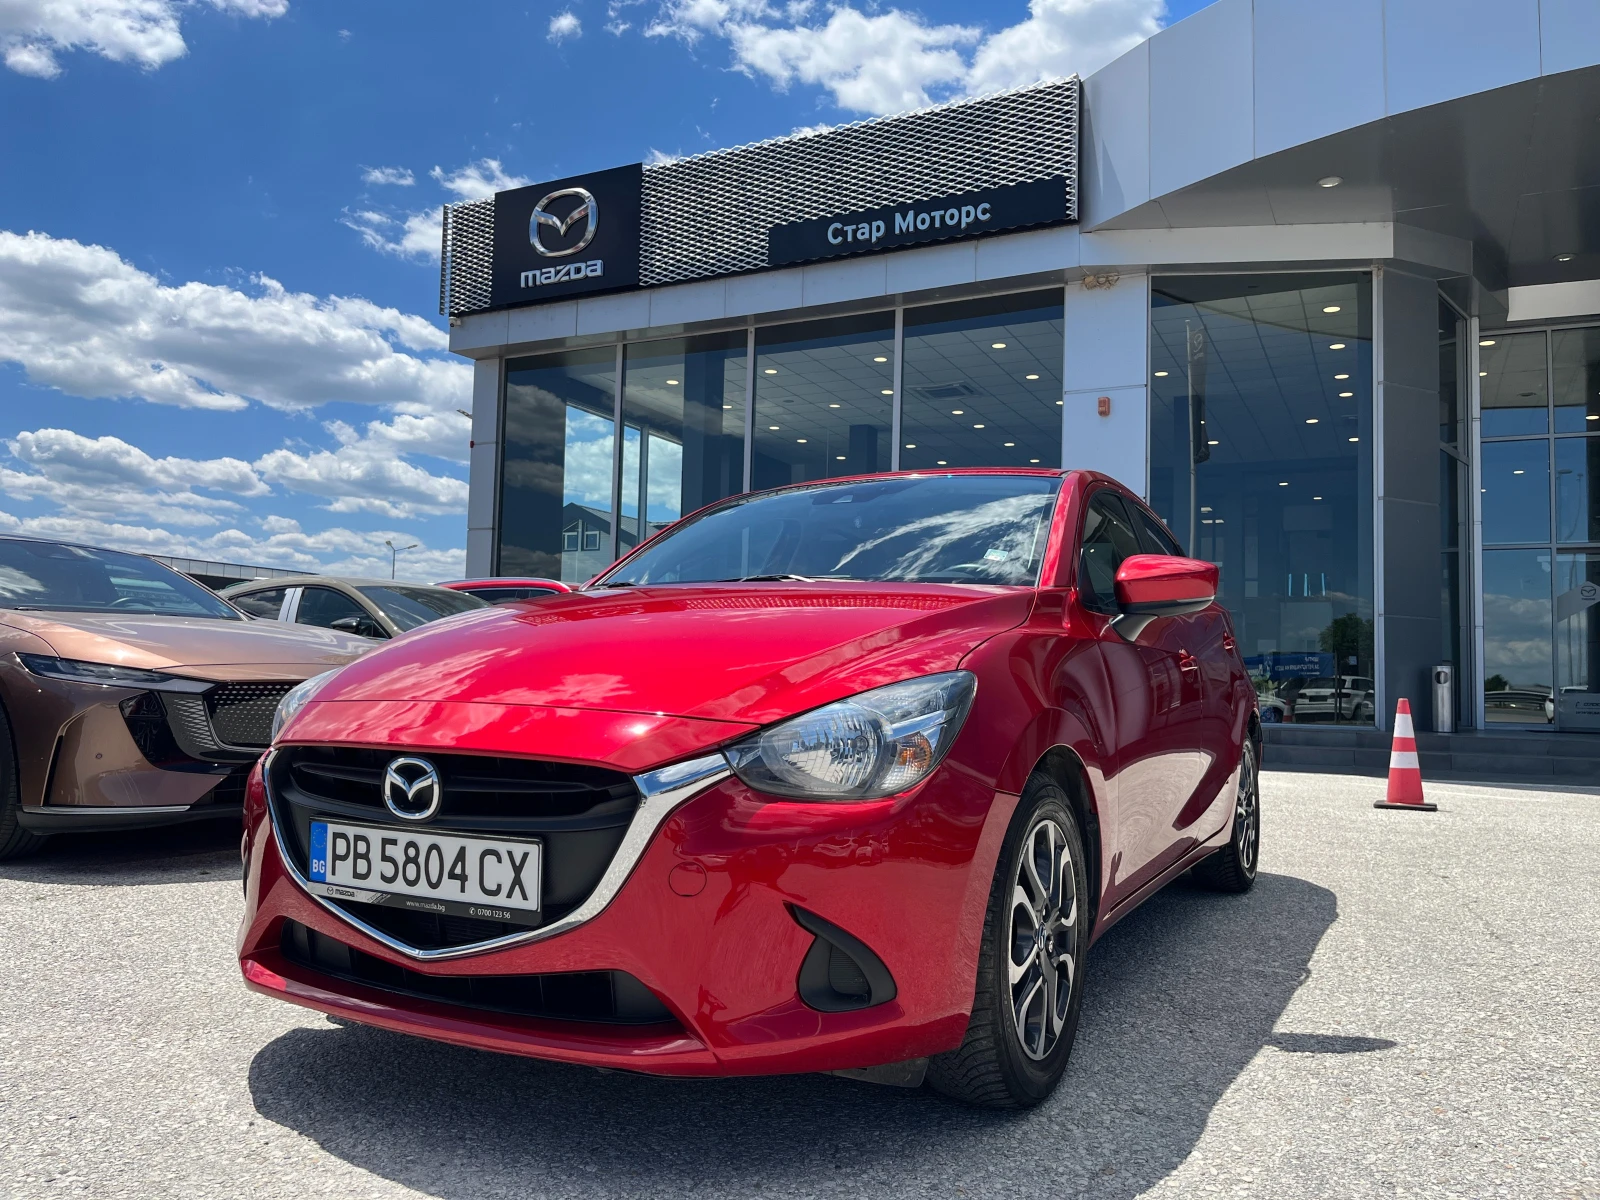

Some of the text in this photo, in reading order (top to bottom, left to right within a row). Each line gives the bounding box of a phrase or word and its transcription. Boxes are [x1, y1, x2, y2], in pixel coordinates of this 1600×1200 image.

[827, 202, 992, 245] Стар Моторс
[520, 259, 604, 288] mazda
[312, 858, 326, 874] BG
[331, 831, 530, 901] PB 5804 CX
[405, 900, 446, 912] www.mazda.bg
[477, 908, 511, 919] 0700 123 56
